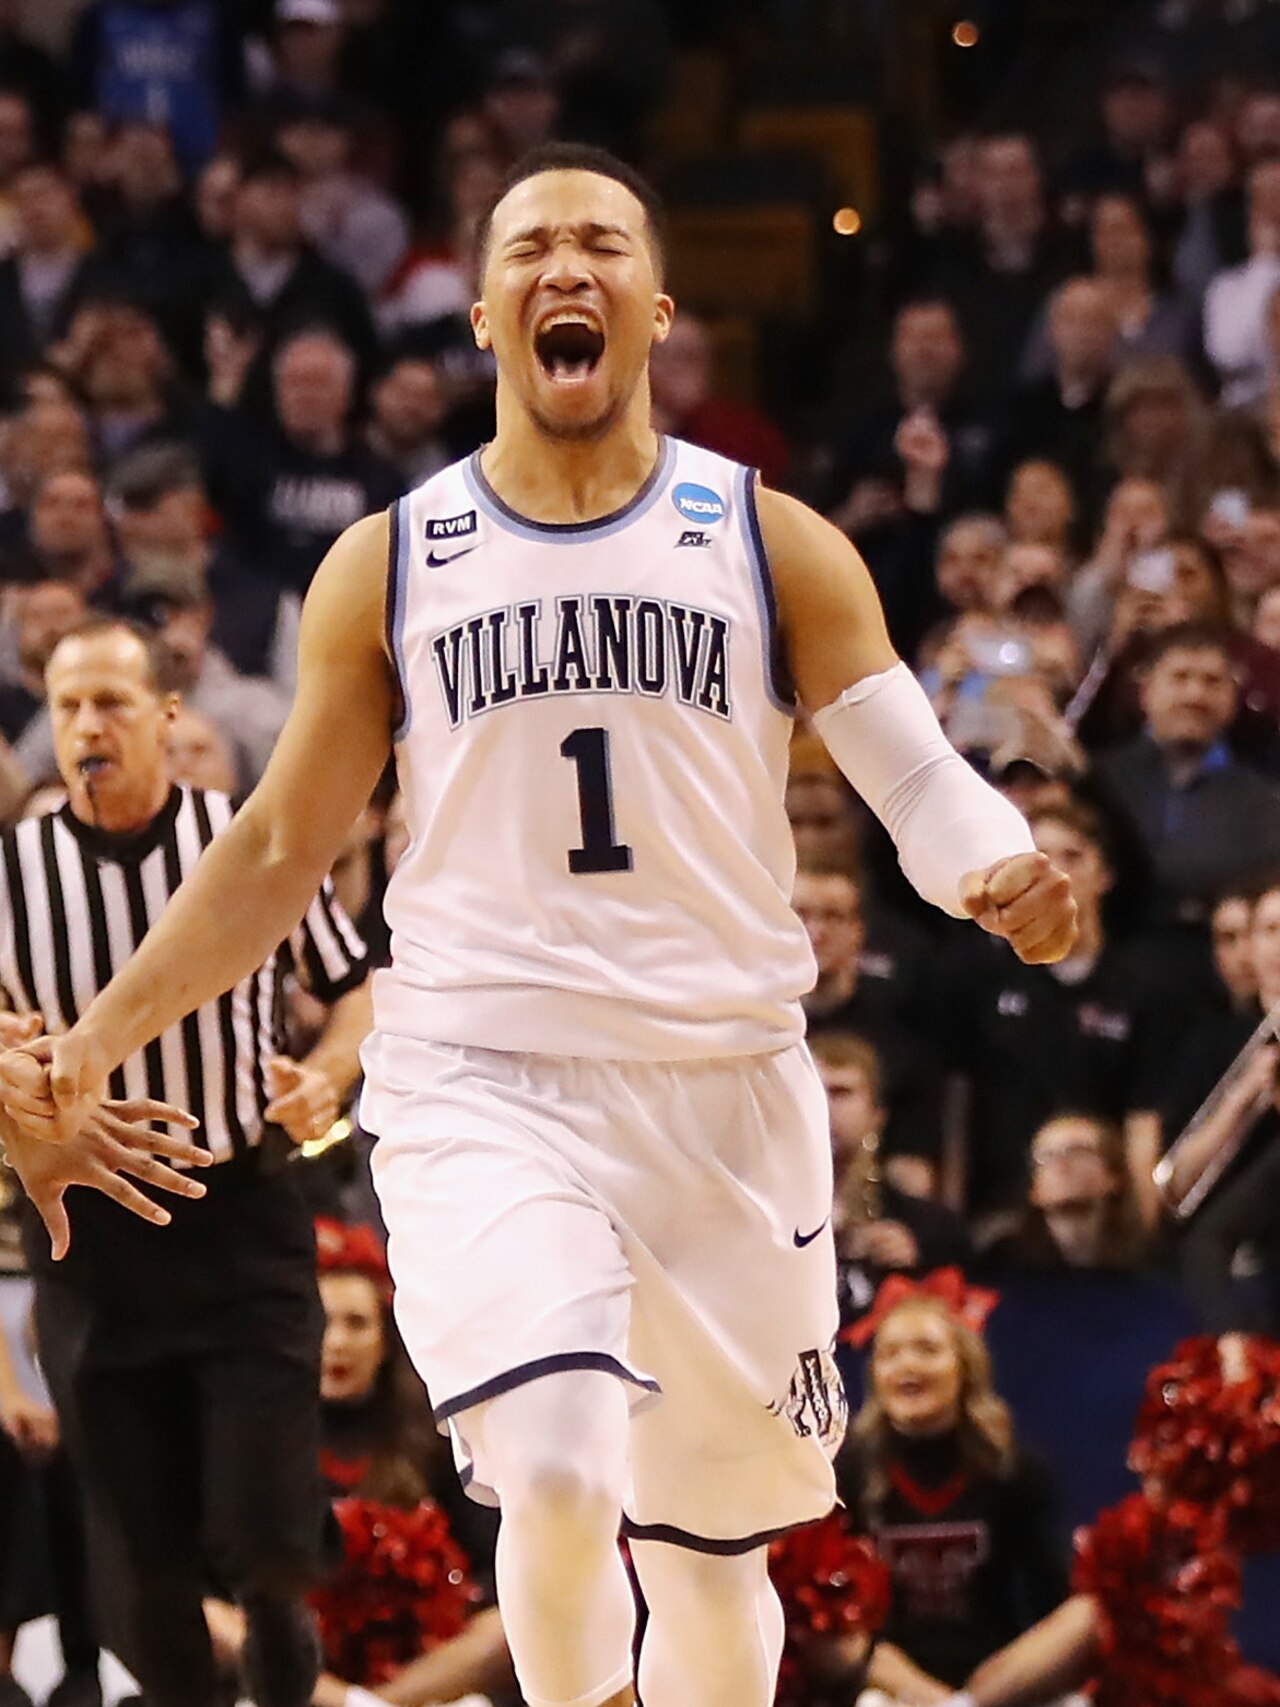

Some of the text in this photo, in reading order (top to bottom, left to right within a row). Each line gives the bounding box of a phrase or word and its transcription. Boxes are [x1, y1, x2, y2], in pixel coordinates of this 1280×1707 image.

[433, 515, 470, 535] RVM
[679, 497, 724, 515] NCAA
[430, 593, 732, 732] VILLANOVA
[560, 727, 633, 874] 1
